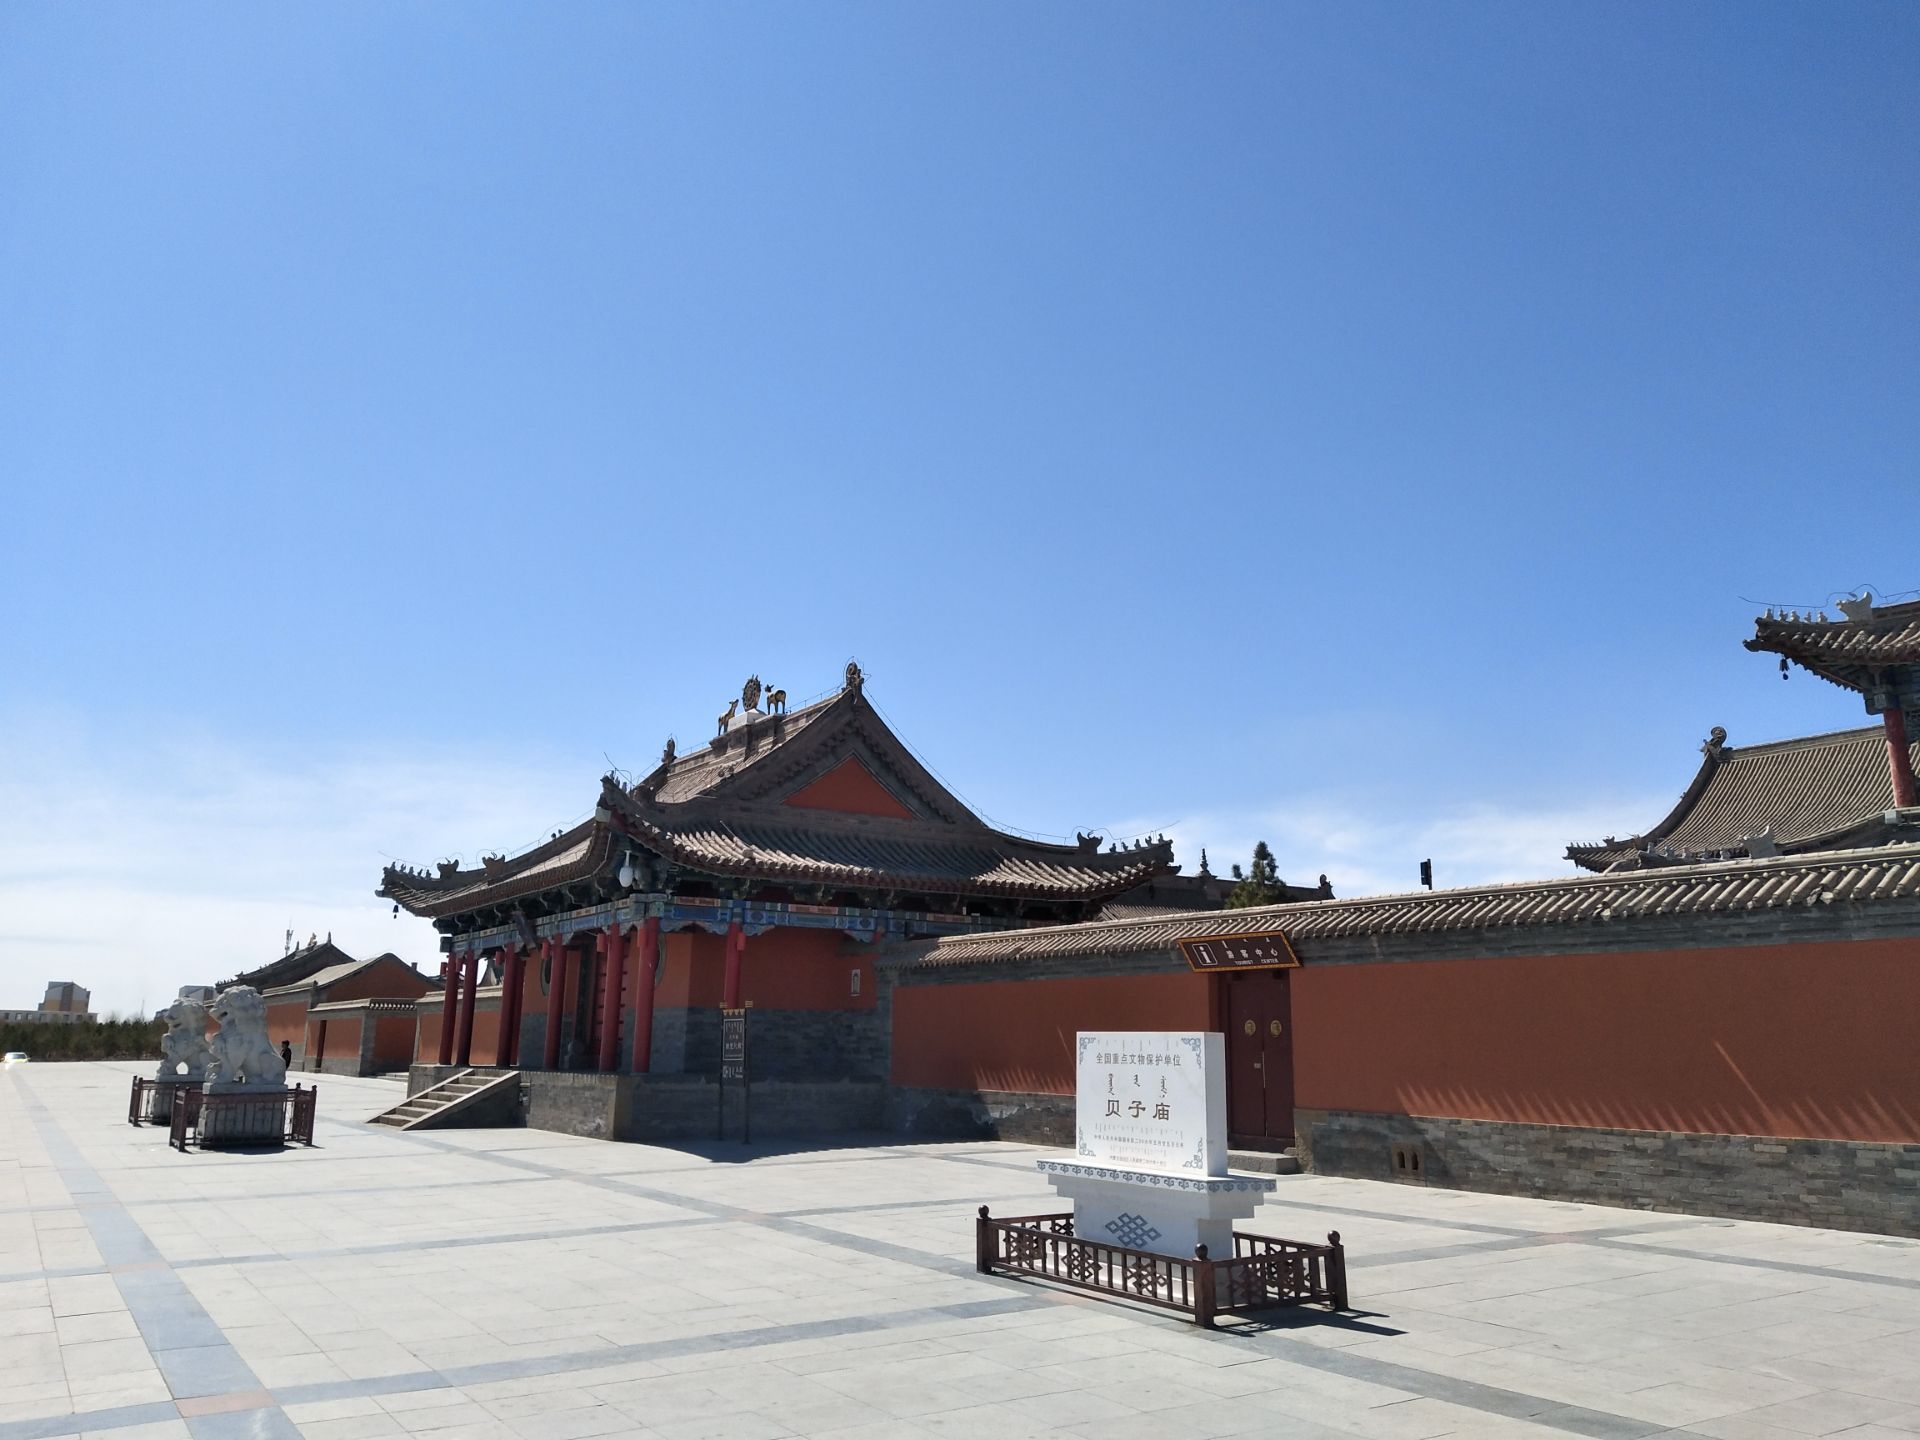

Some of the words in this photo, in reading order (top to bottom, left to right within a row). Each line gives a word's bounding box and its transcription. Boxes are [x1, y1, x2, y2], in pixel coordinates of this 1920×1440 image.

[1096, 1052, 1181, 1067] 全国重点文物保护单位
[1105, 1099, 1171, 1121] 贝子庙
